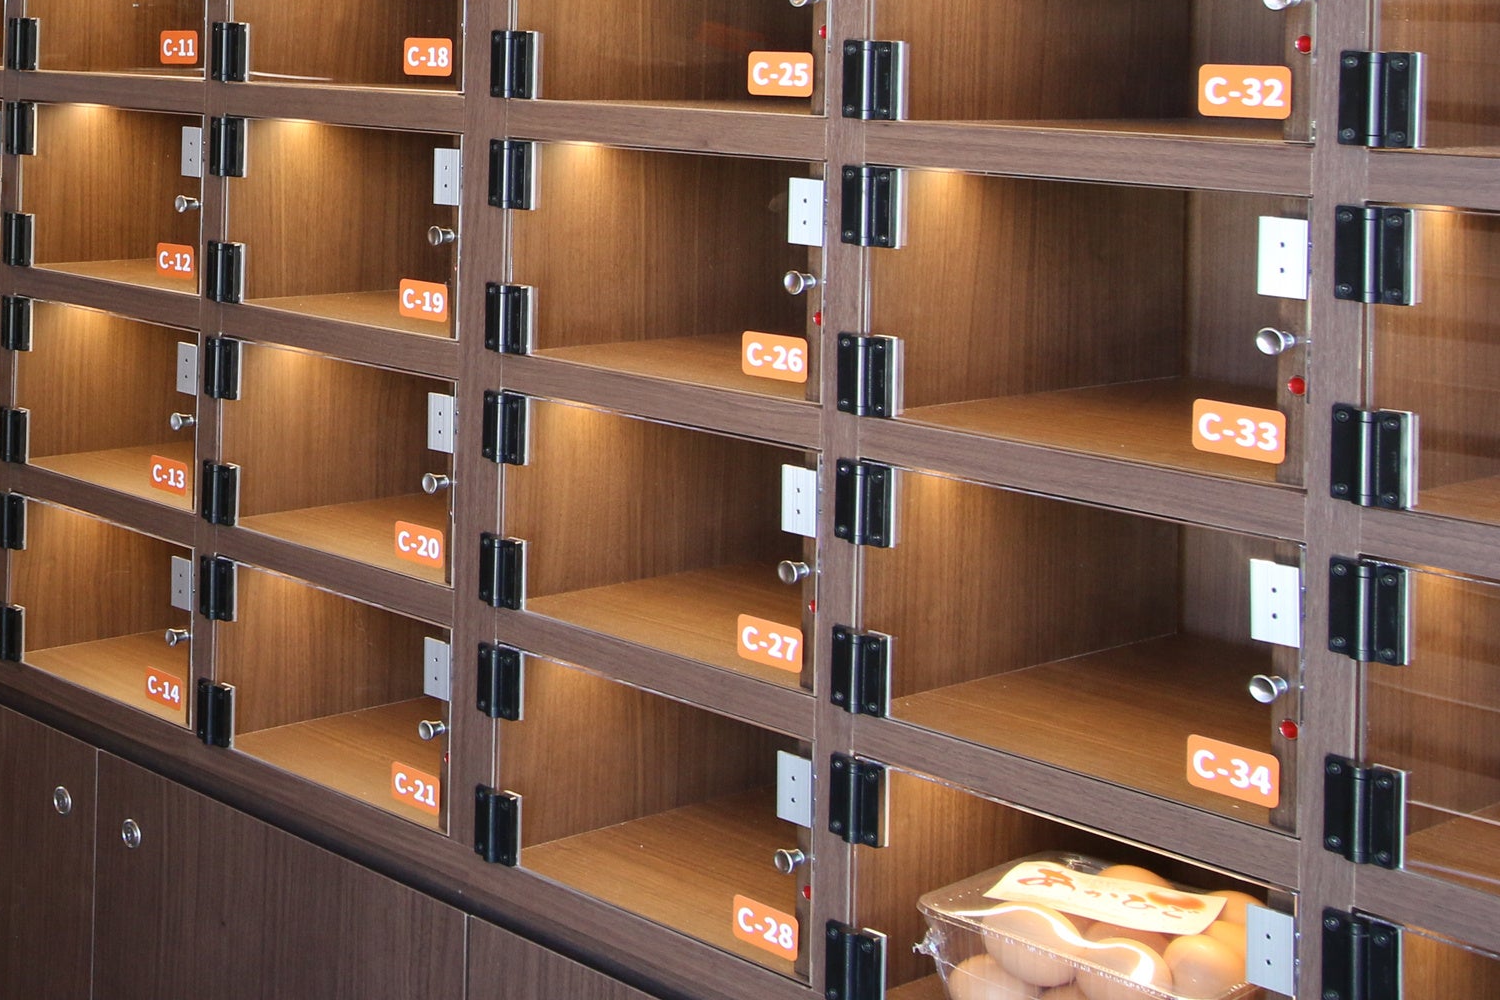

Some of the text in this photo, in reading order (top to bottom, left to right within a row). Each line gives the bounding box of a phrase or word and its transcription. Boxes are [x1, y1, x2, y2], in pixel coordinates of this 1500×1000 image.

[163, 38, 195, 57] C-11
[407, 46, 449, 68] C-18
[752, 61, 810, 87] C-25
[1204, 76, 1286, 107] C-32
[159, 250, 191, 272] C-12
[402, 288, 445, 314] C-19
[746, 342, 805, 373] C-26
[1198, 412, 1280, 452] C-33
[152, 464, 185, 489] C-13
[397, 530, 441, 560] C-20
[741, 625, 800, 662] C-27
[147, 675, 180, 704] C-14
[1192, 749, 1273, 796] C-34
[394, 772, 436, 807] C-21
[737, 907, 795, 950] C-28
